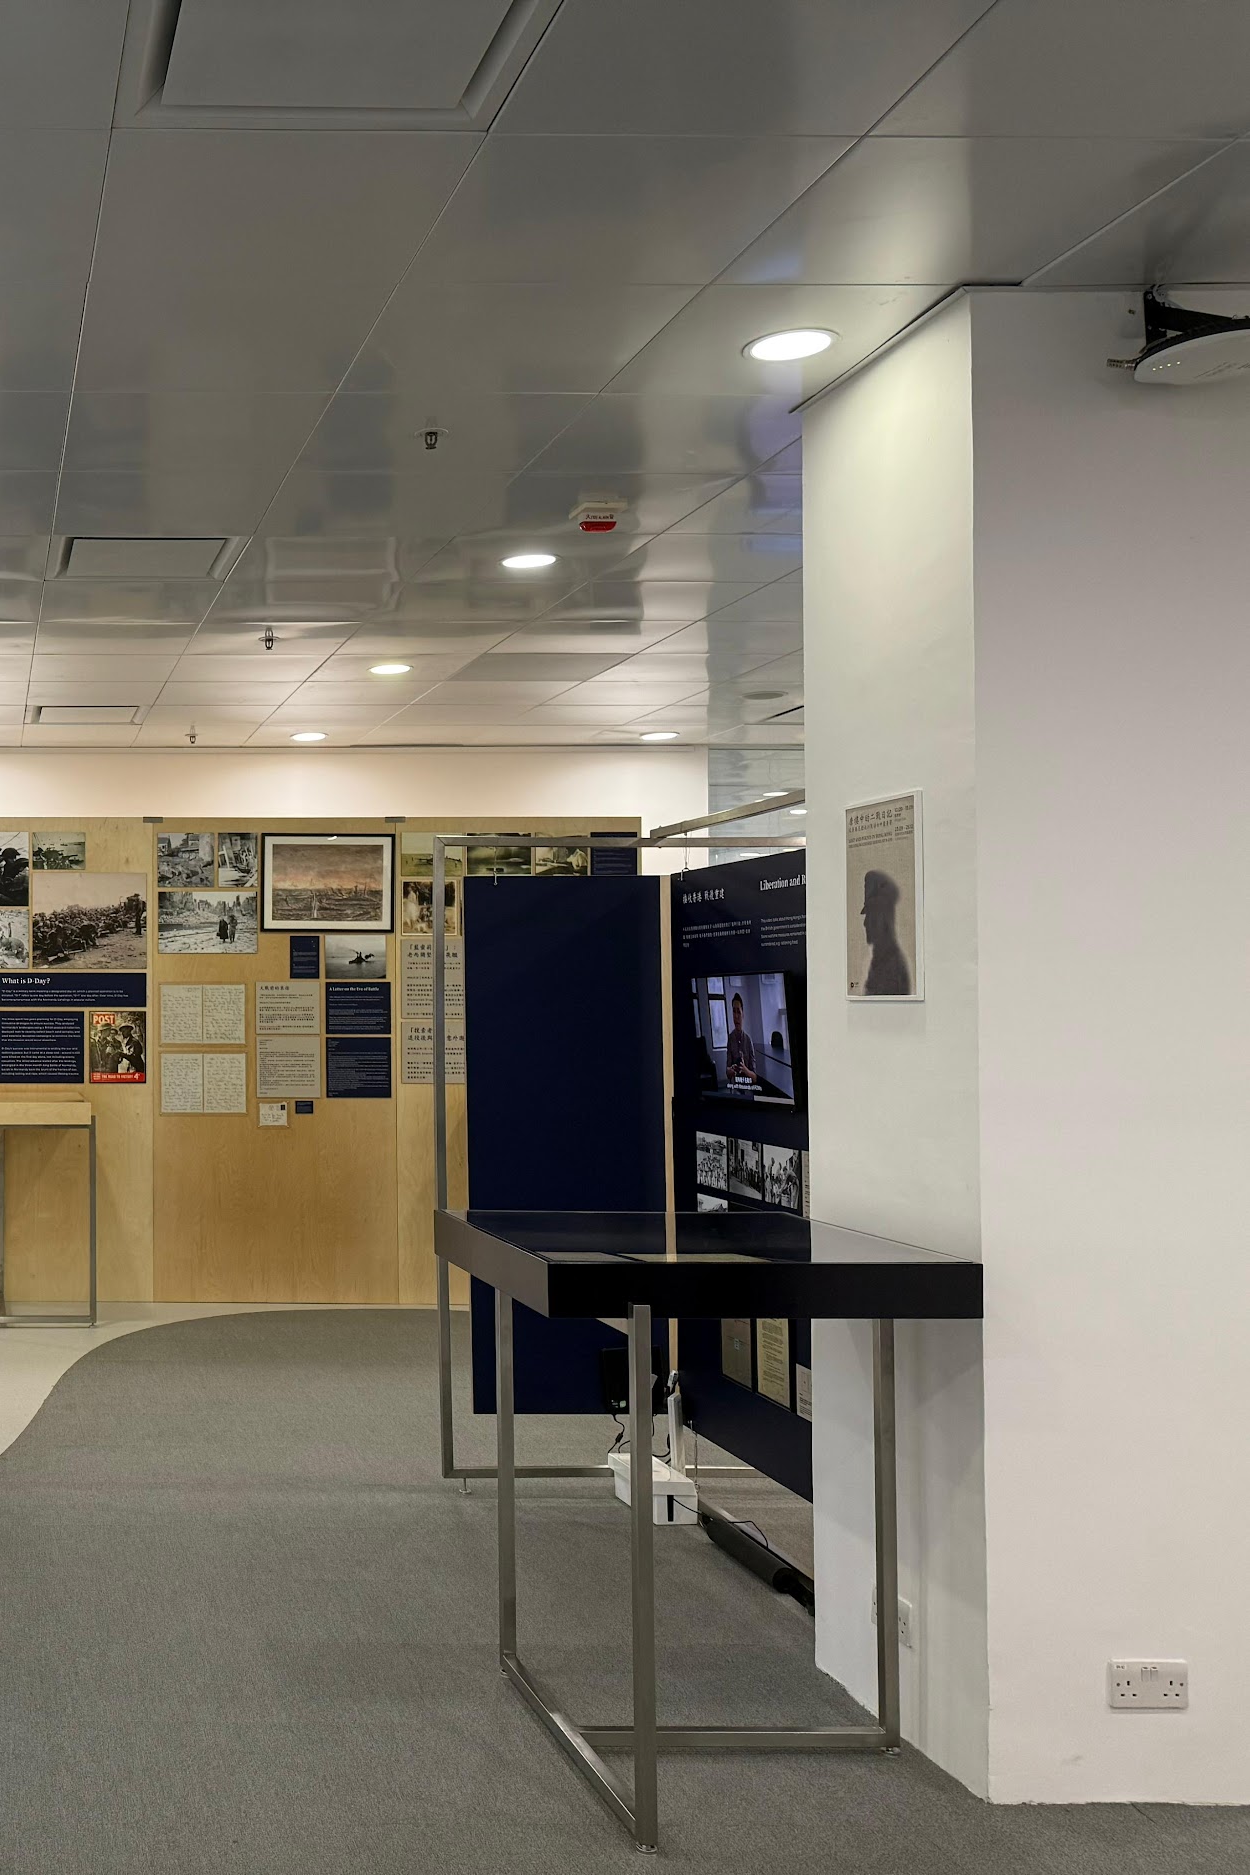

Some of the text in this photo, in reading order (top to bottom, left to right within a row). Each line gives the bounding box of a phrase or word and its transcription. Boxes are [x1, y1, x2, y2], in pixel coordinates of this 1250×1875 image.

[760, 878, 788, 890] Liberation
[790, 875, 800, 886] and
[94, 1015, 114, 1024] POST
